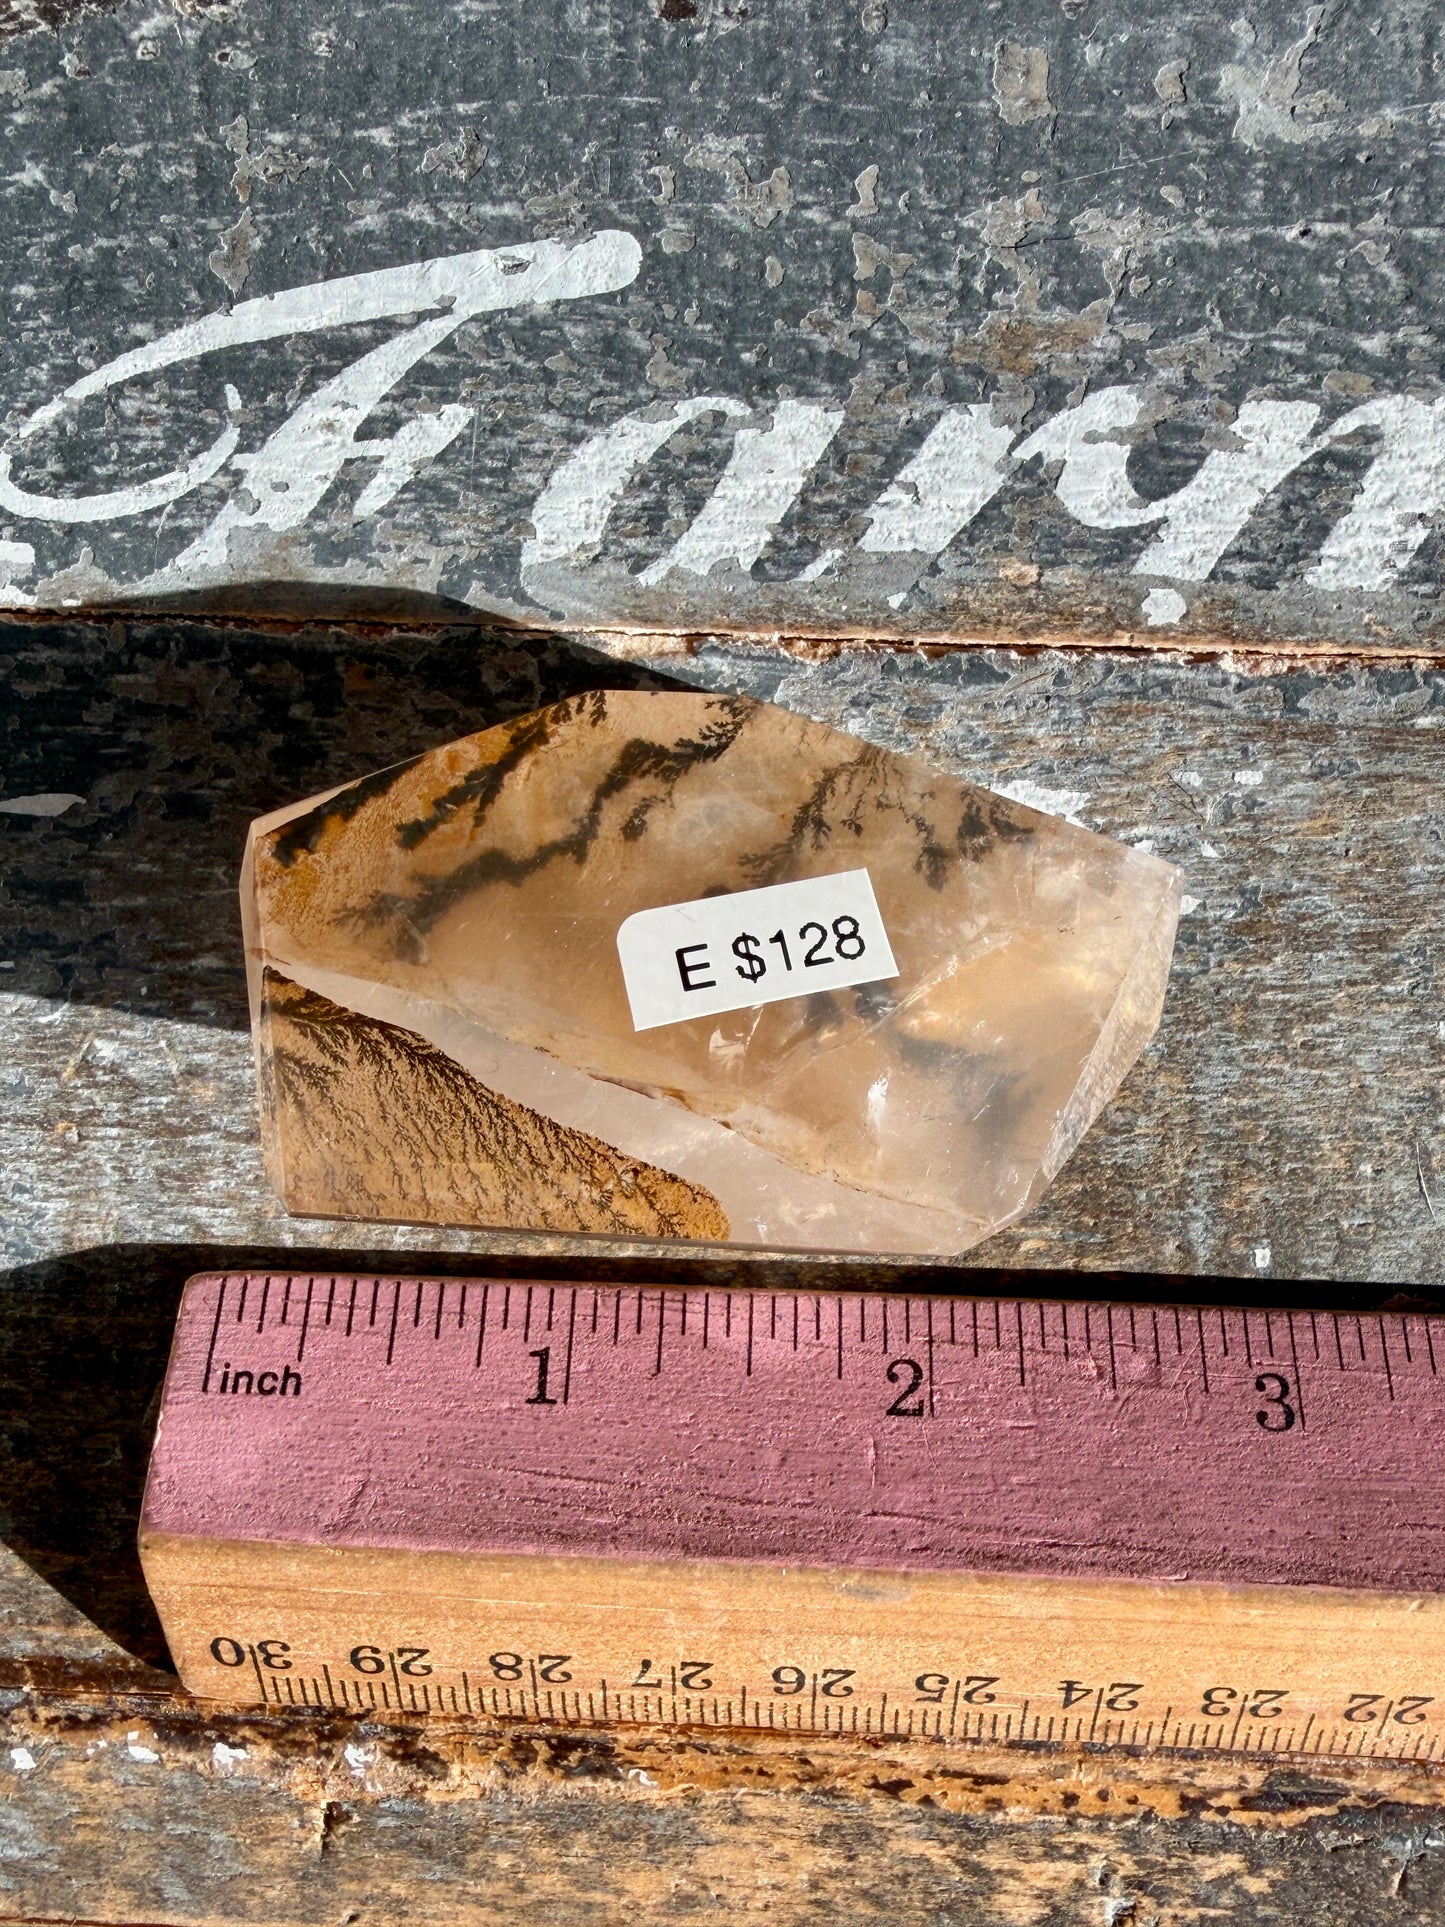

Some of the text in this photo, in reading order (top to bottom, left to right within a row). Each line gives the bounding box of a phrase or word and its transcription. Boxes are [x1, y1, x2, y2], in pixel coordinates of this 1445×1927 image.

[675, 915, 866, 992] E $128
[219, 1346, 1297, 1433] inch 1 2 3
[209, 1636, 1436, 1726] 22 23 24 25 26 27 28 29 30
